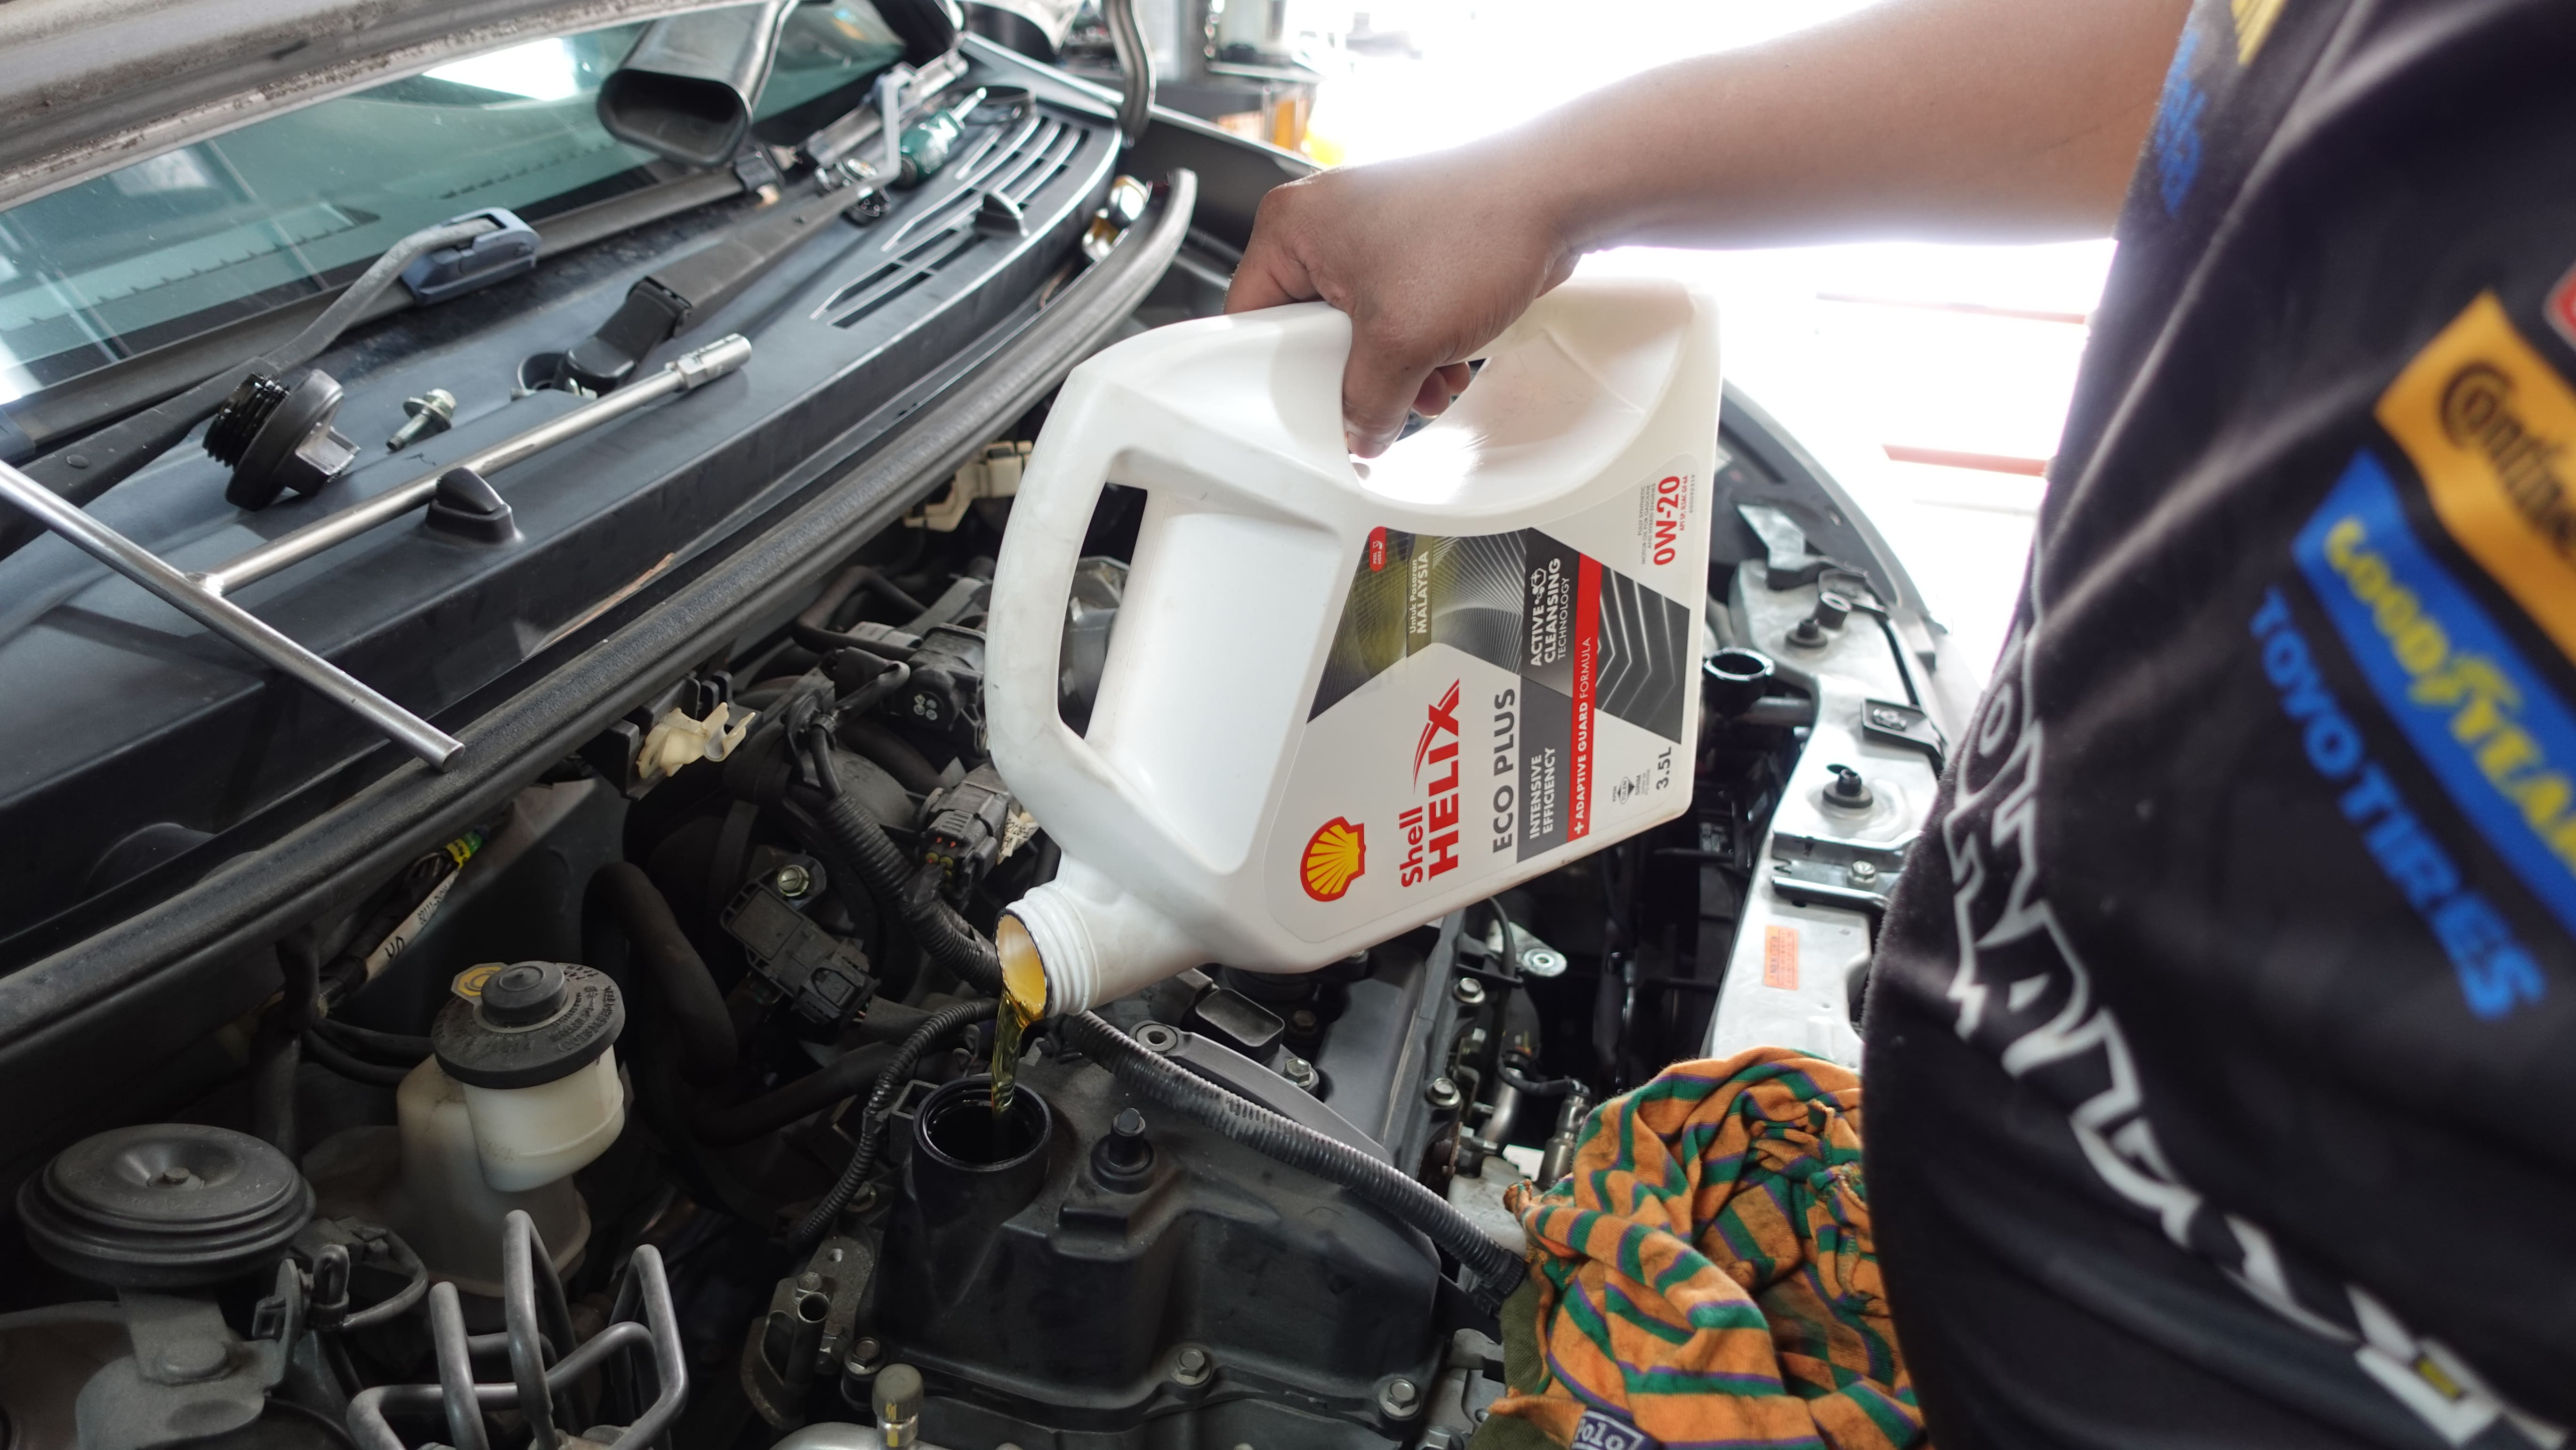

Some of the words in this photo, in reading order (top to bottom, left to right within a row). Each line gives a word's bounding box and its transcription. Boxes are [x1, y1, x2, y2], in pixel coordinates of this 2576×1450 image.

[1653, 476, 1680, 565] 0W-20
[1417, 551, 1428, 634] MALAYSIA
[1544, 558, 1561, 663] CLEANSING
[1558, 578, 1570, 660] TECHNOLOGY
[1530, 605, 1544, 667] ACTIVE
[1579, 637, 1591, 699] FORMULA
[1493, 688, 1515, 777] PLUS
[1577, 701, 1588, 752] GUARD
[1427, 678, 1459, 882] HELIX
[1530, 754, 1543, 840] INTENSIVE
[1543, 747, 1555, 834] EFFICIENCY
[1575, 753, 1587, 819] ADAPTIVE
[1656, 746, 1672, 790] 3.5L
[2251, 584, 2362, 781] TOYO
[2339, 759, 2547, 1020] TIRES
[1399, 806, 1423, 887] Shell
[1492, 785, 1514, 854] ECO
